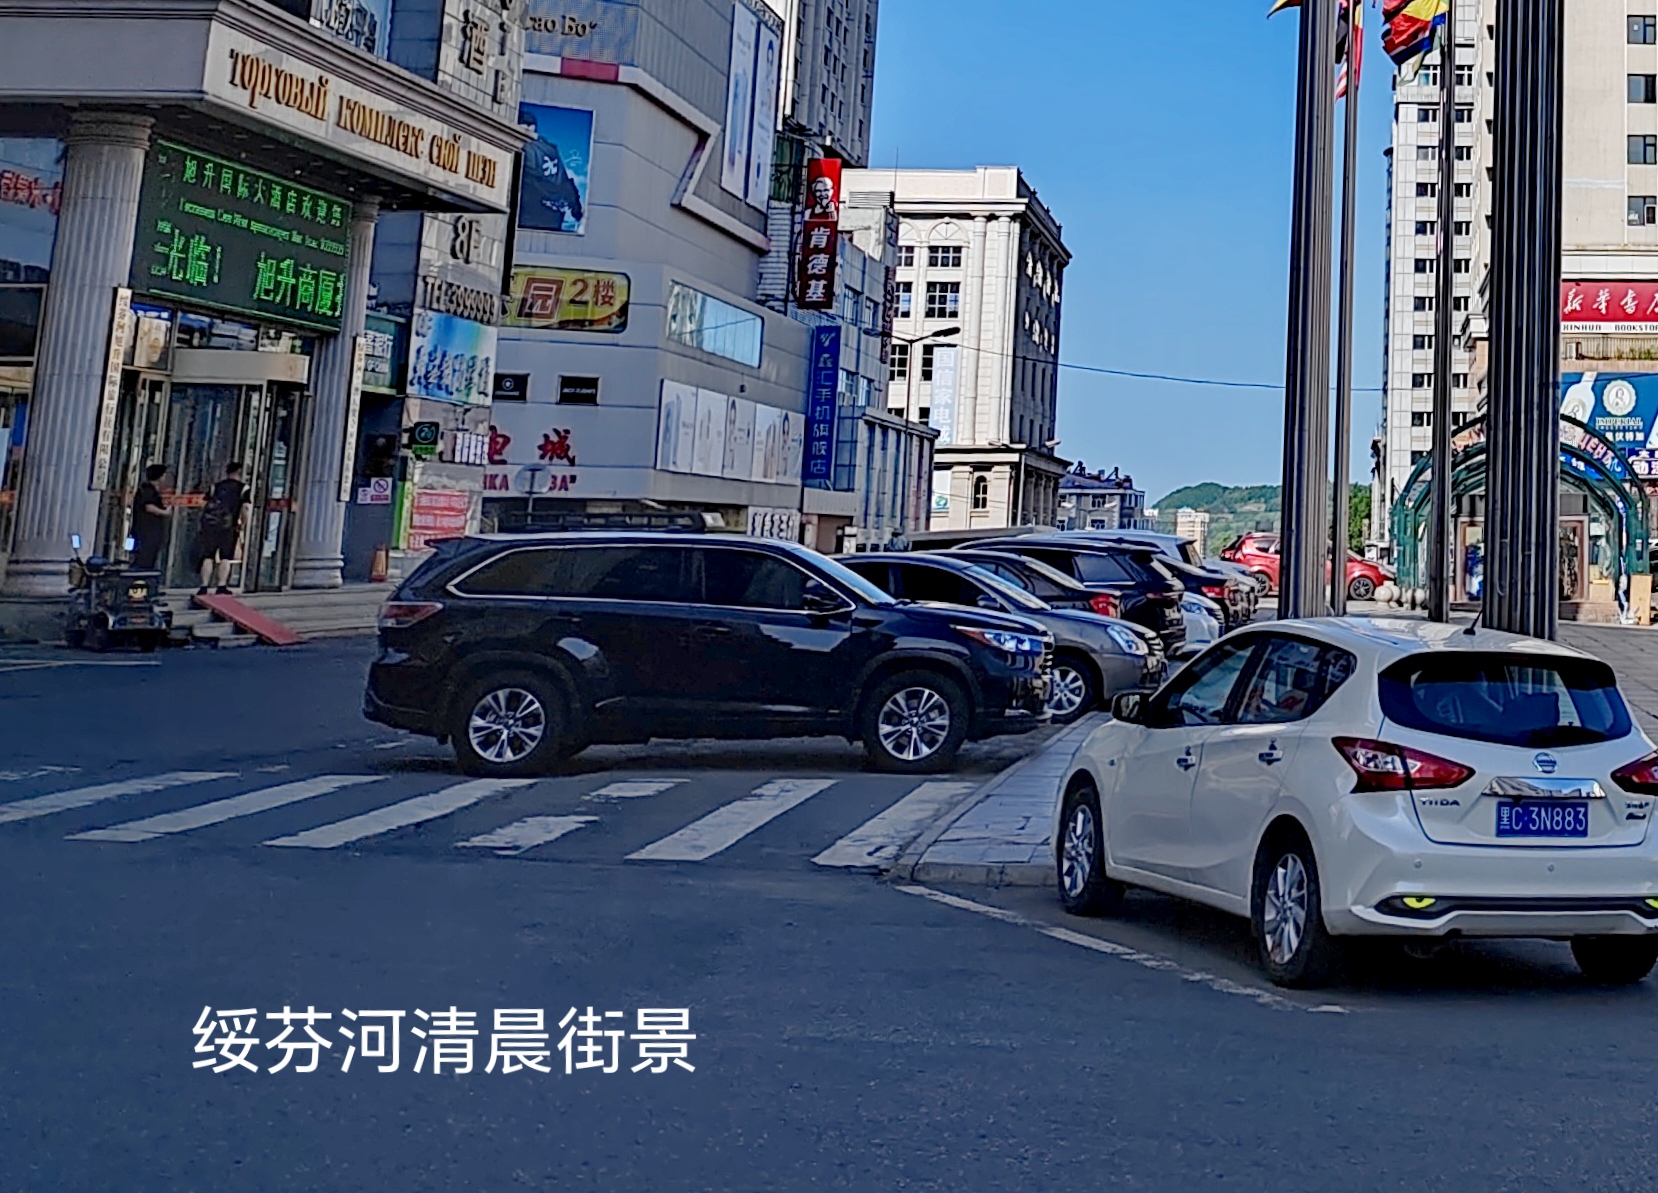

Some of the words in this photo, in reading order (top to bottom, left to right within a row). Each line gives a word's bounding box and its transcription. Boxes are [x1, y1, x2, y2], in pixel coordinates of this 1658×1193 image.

[804, 227, 831, 302] 肯德基
[1421, 797, 1461, 807] TIIDA
